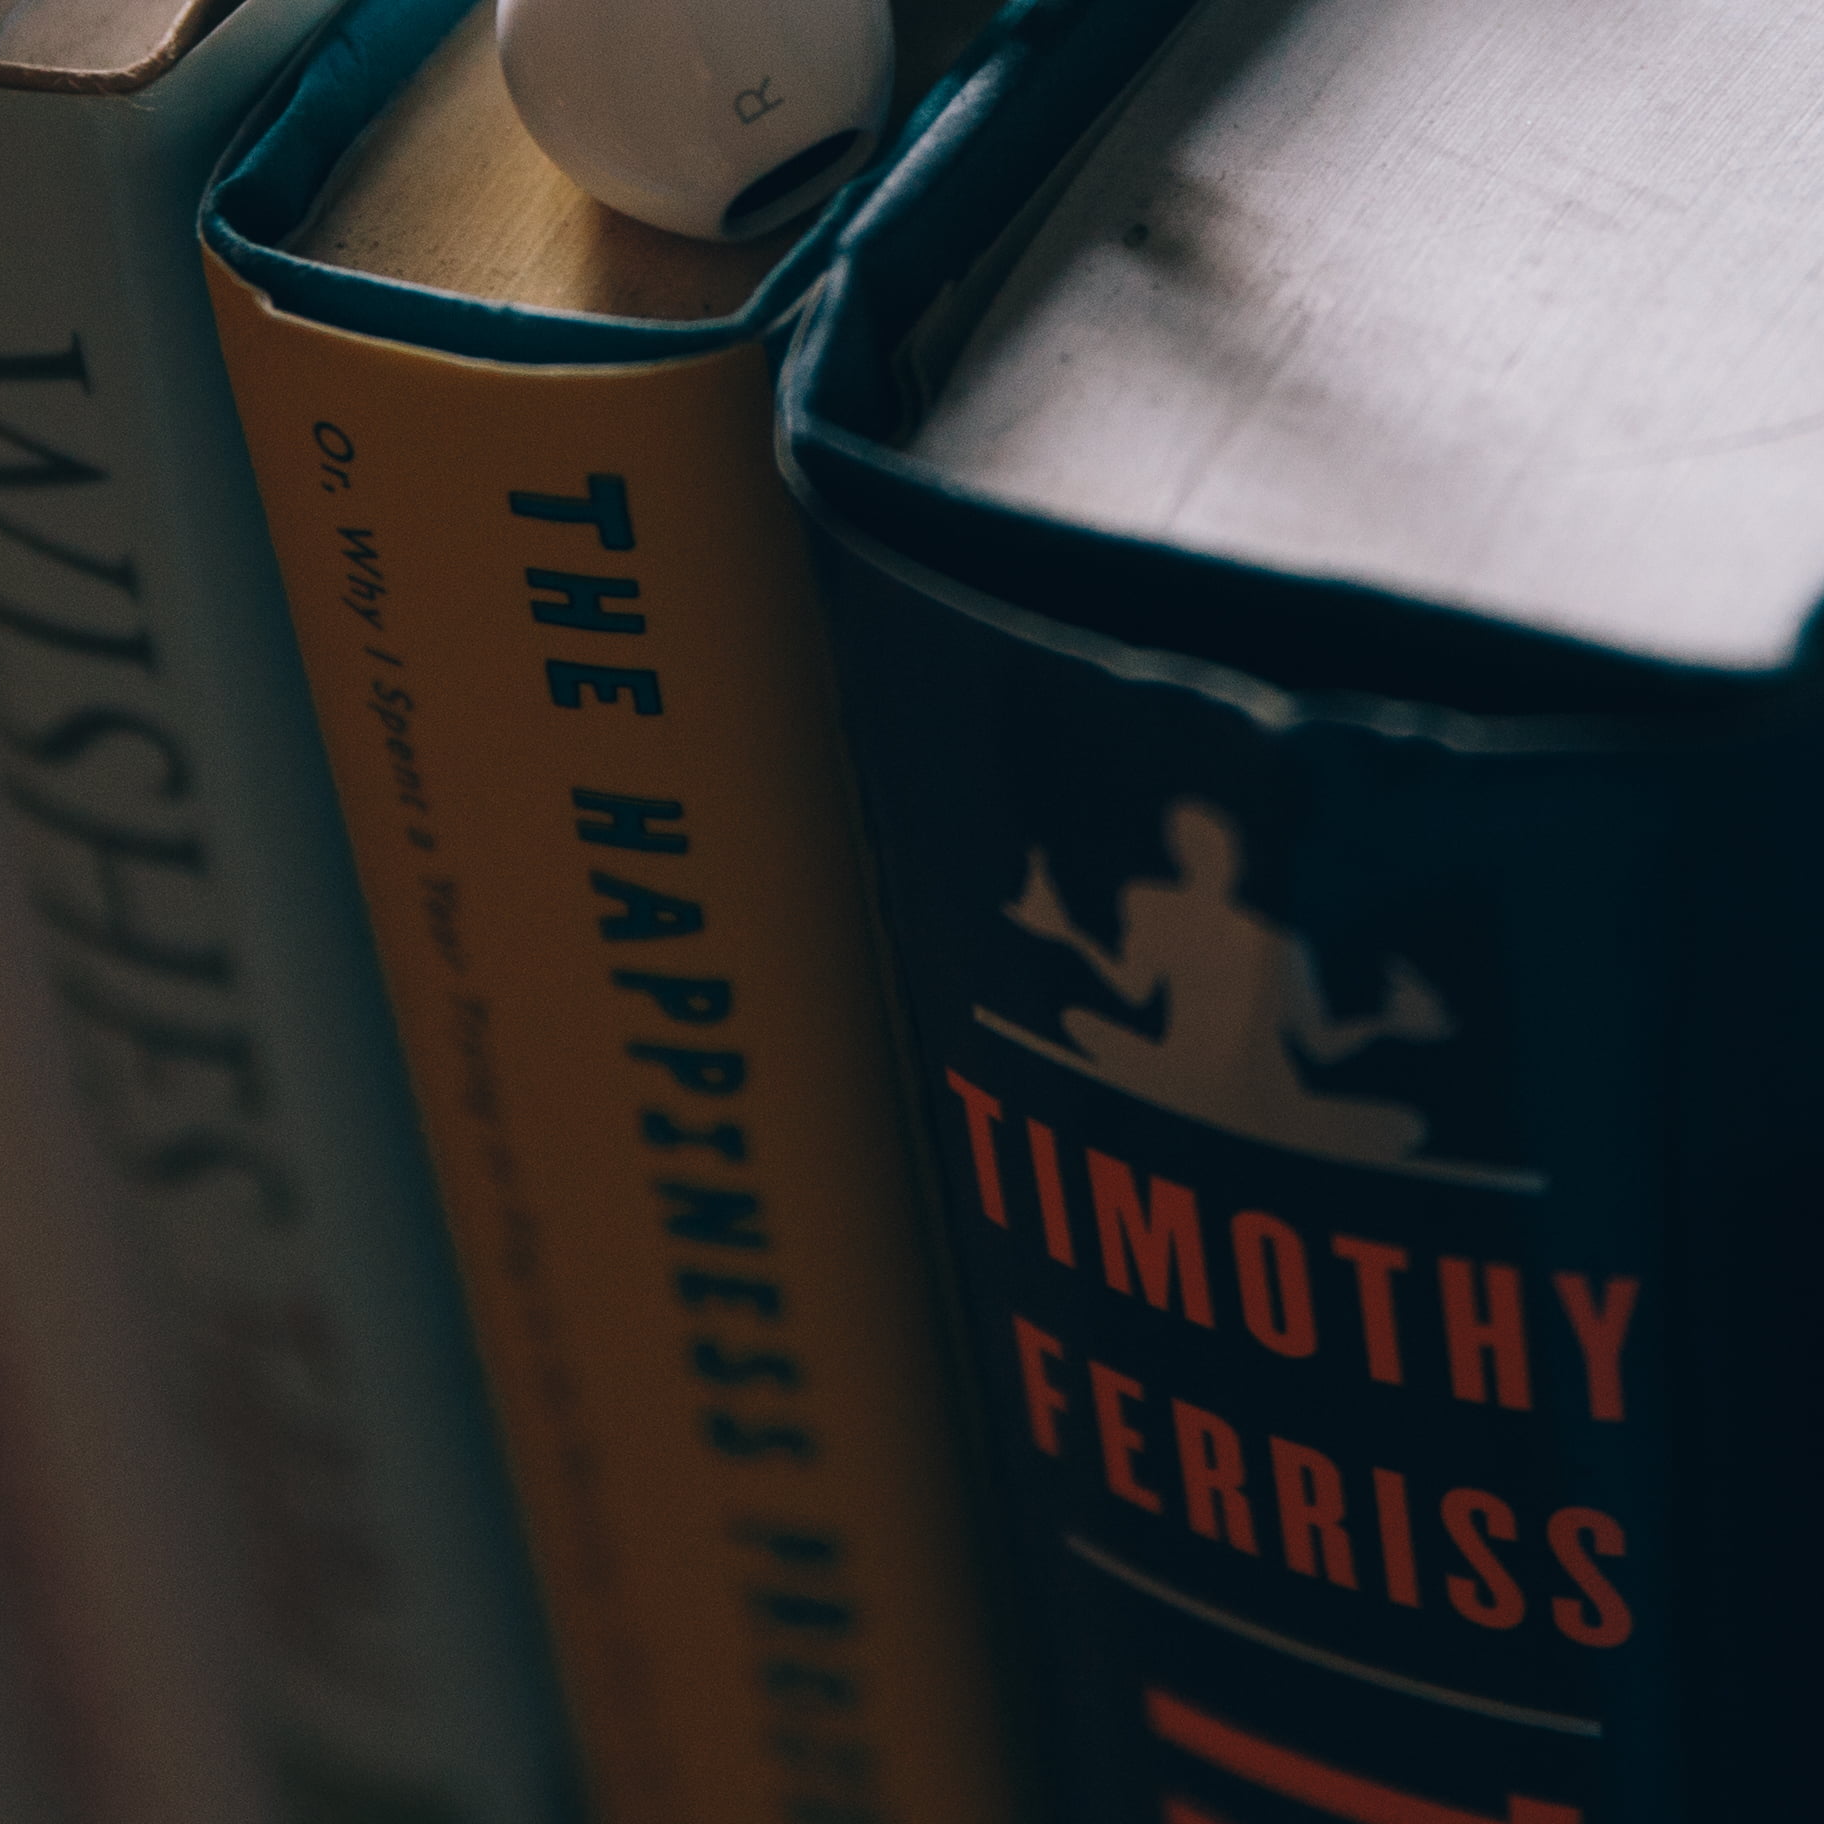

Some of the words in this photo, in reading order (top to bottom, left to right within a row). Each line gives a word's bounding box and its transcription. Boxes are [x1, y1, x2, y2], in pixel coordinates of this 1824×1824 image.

[733, 78, 785, 126] R
[314, 421, 354, 493] Or,
[337, 526, 388, 631] Why
[508, 473, 663, 716] THE
[364, 645, 404, 667] I
[366, 680, 429, 816] Spent
[572, 786, 814, 1458] HAPPINESS
[944, 1064, 1642, 1426] TIMOTHY
[1010, 1310, 1634, 1650] FERRISS
